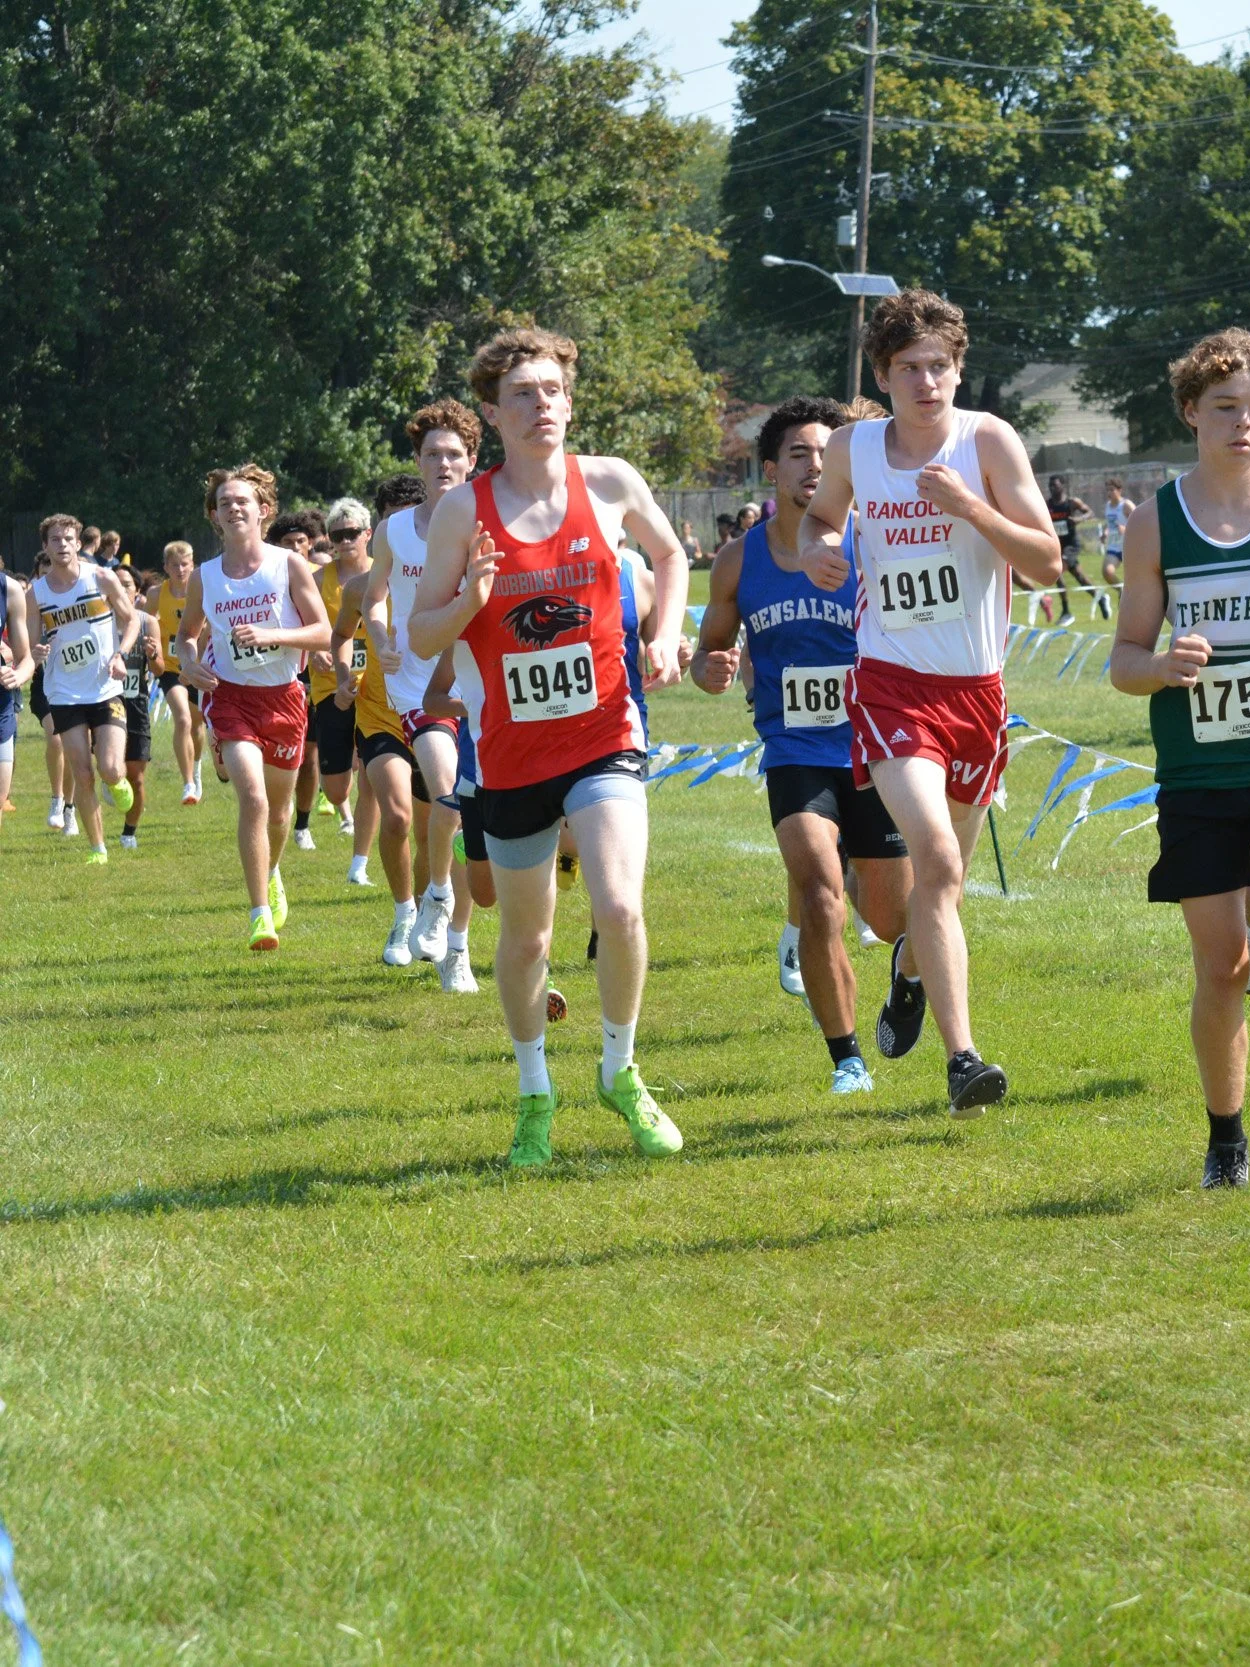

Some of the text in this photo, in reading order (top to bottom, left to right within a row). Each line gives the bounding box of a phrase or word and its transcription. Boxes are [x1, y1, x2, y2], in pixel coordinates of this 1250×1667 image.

[866, 500, 944, 519] RANCOC
[885, 523, 953, 545] VALLEY
[880, 565, 959, 612] 1910
[51, 604, 88, 626] MCNAIR
[215, 592, 277, 614] RANCOCAS
[229, 610, 271, 627] VALLEY
[749, 598, 854, 634] BENSALEM
[61, 639, 96, 665] 1870
[508, 656, 593, 704] 1949
[786, 678, 845, 712] 168
